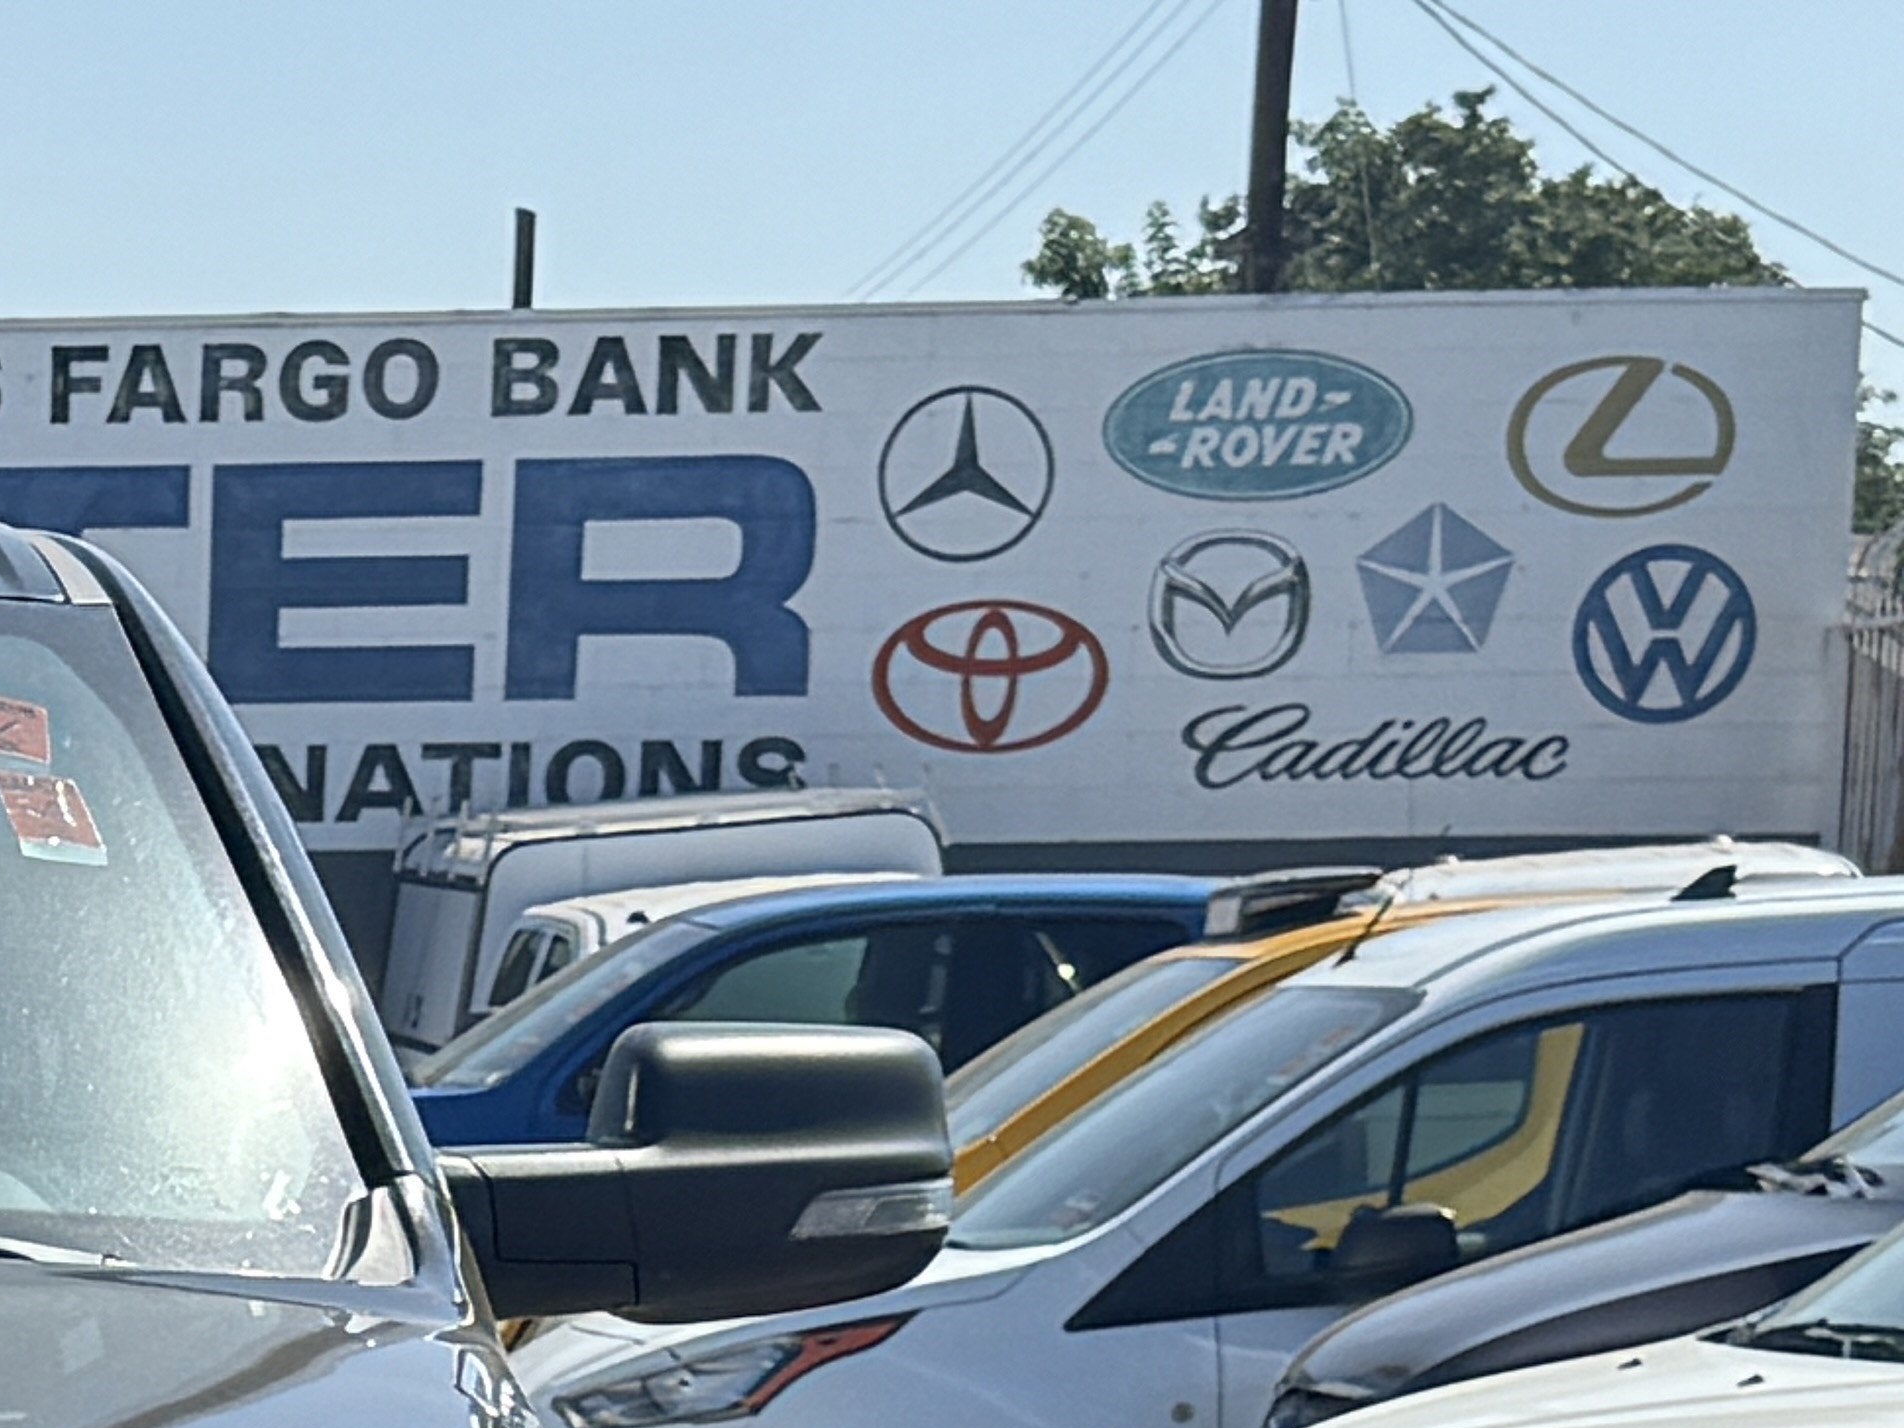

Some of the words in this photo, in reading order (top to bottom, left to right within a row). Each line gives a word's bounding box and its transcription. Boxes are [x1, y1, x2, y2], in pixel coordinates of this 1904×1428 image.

[50, 338, 439, 425] FARGO
[490, 332, 822, 418] BANK
[1181, 702, 1570, 790] Cadillac
